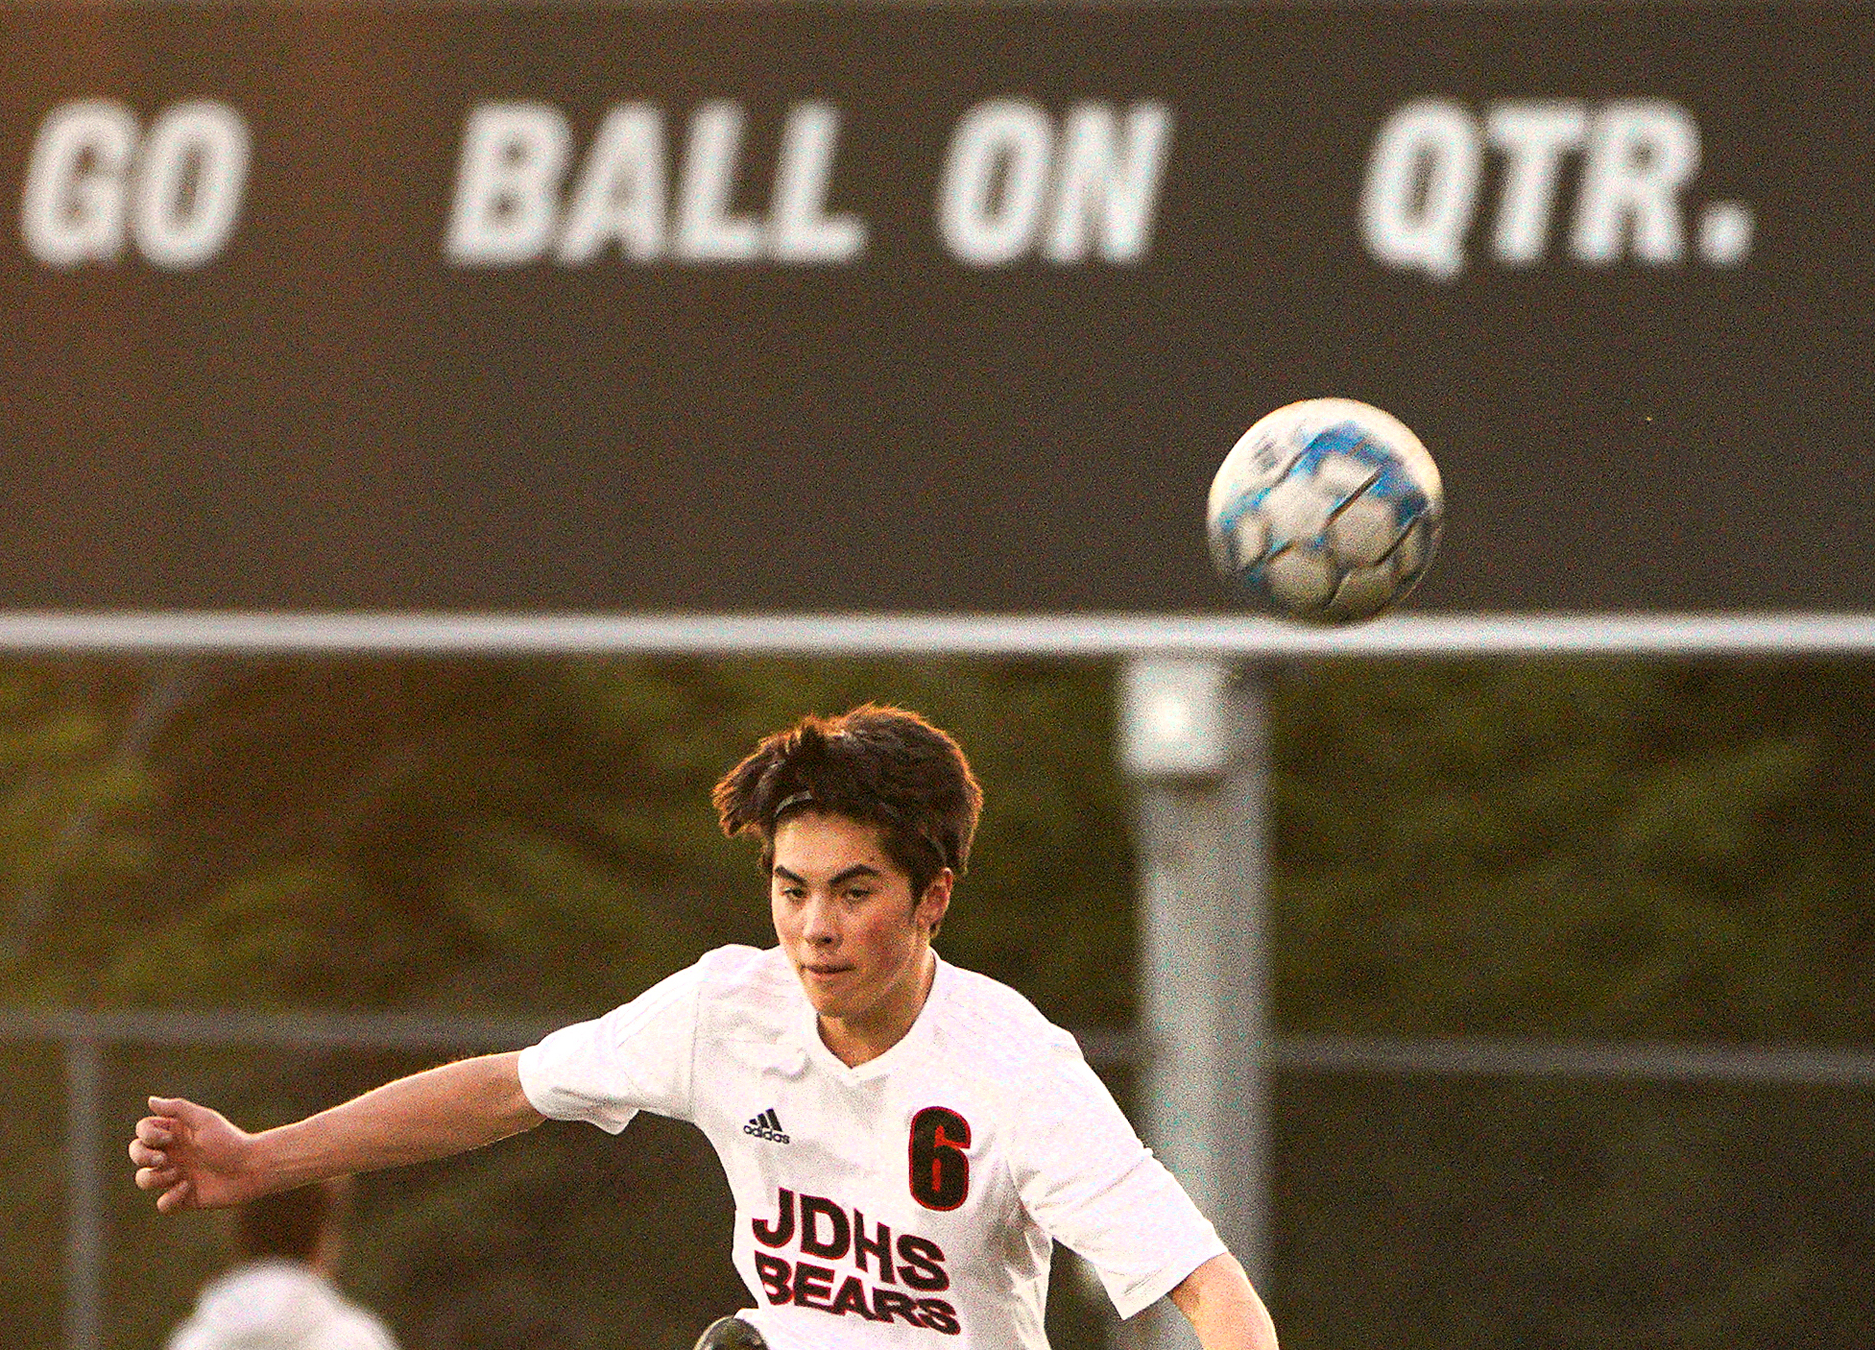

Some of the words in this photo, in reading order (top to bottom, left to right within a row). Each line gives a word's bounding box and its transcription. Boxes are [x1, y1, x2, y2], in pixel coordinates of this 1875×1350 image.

[18, 99, 252, 268] GO
[445, 100, 867, 267] BALL
[936, 99, 1171, 267] ON
[1358, 100, 1755, 282] QTR.
[743, 1124, 790, 1144] adidas
[908, 1105, 972, 1212] 6
[751, 1186, 951, 1292] JDHS
[754, 1249, 962, 1336] BEARS
